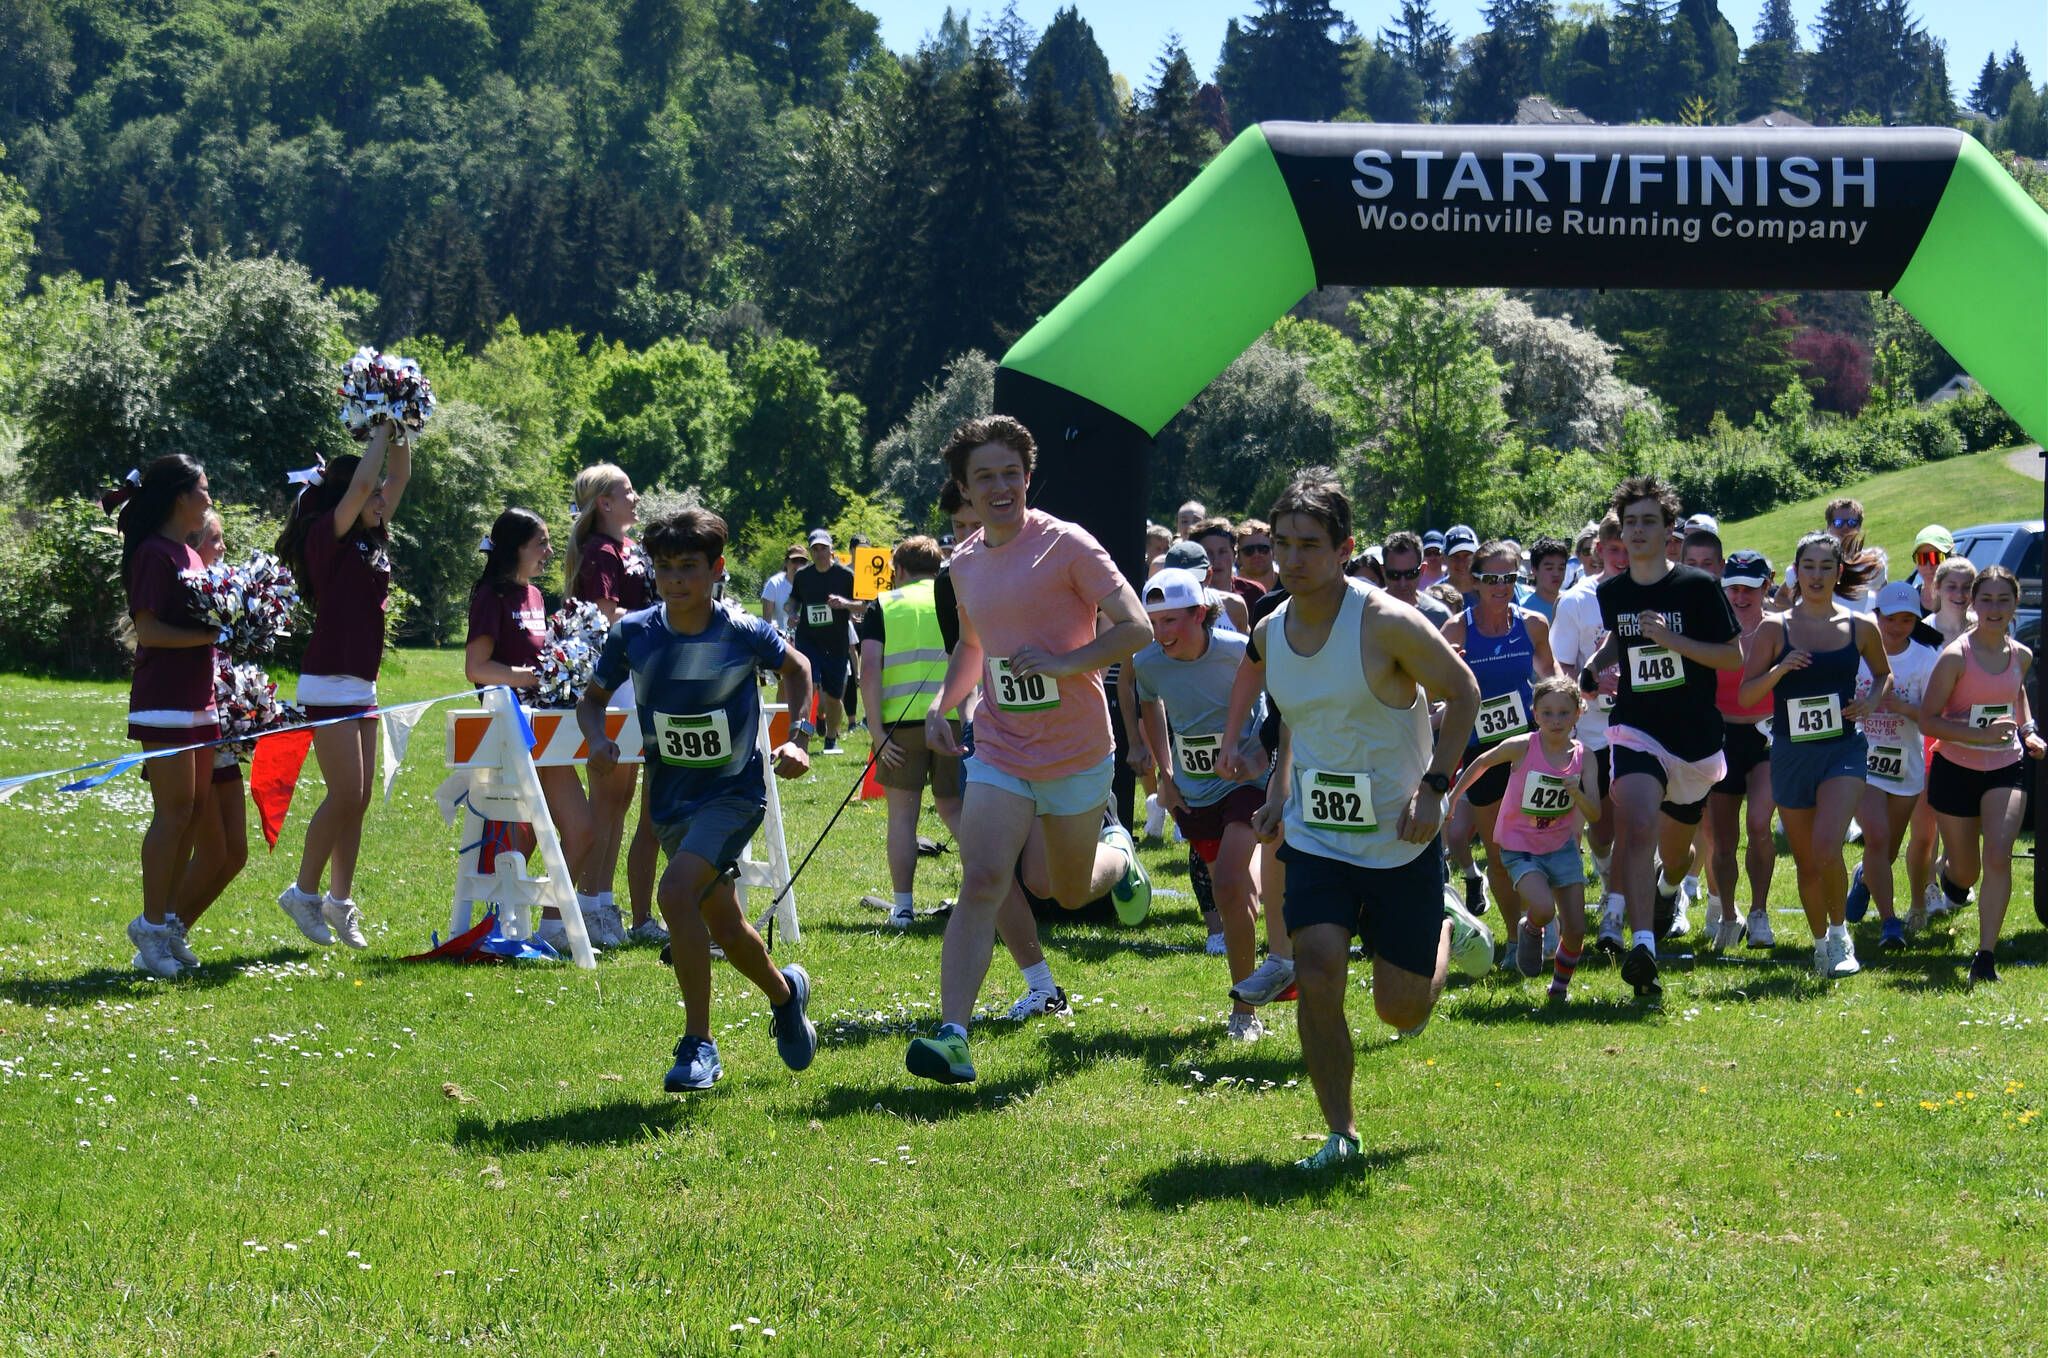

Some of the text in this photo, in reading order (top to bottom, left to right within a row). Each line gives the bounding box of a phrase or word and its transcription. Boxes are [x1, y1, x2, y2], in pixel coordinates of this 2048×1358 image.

[1350, 149, 1877, 209] START/FINISH
[1356, 204, 1868, 246] Woodinville Running Company
[811, 611, 828, 624] 377
[1637, 656, 1676, 683] 448
[1000, 673, 1046, 702] 310
[1480, 706, 1520, 734] 334
[1798, 708, 1834, 733] 431
[664, 729, 723, 759] 398
[1868, 755, 1902, 777] 394
[1311, 789, 1364, 823] 382
[1529, 788, 1570, 809] 426
